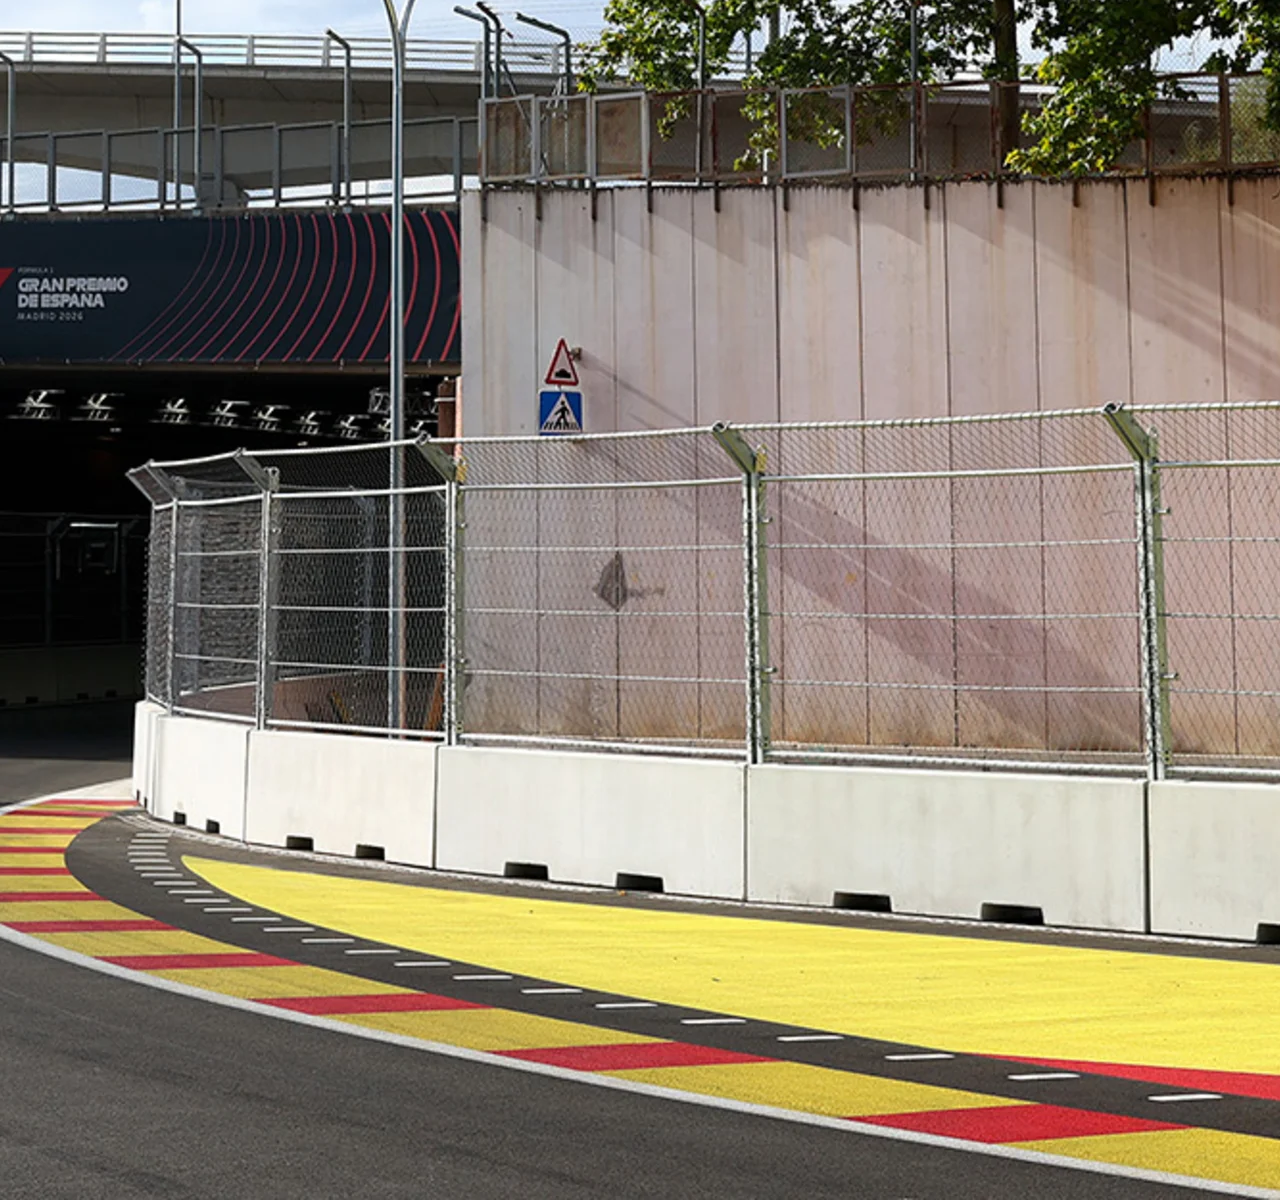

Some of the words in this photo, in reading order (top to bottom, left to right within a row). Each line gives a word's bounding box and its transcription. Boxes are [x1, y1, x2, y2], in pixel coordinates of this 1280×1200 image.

[18, 278, 64, 292] GRAN
[66, 277, 129, 292] PREMIO
[18, 293, 39, 308] DE
[17, 312, 57, 320] MADRID
[59, 312, 84, 320] 2026
